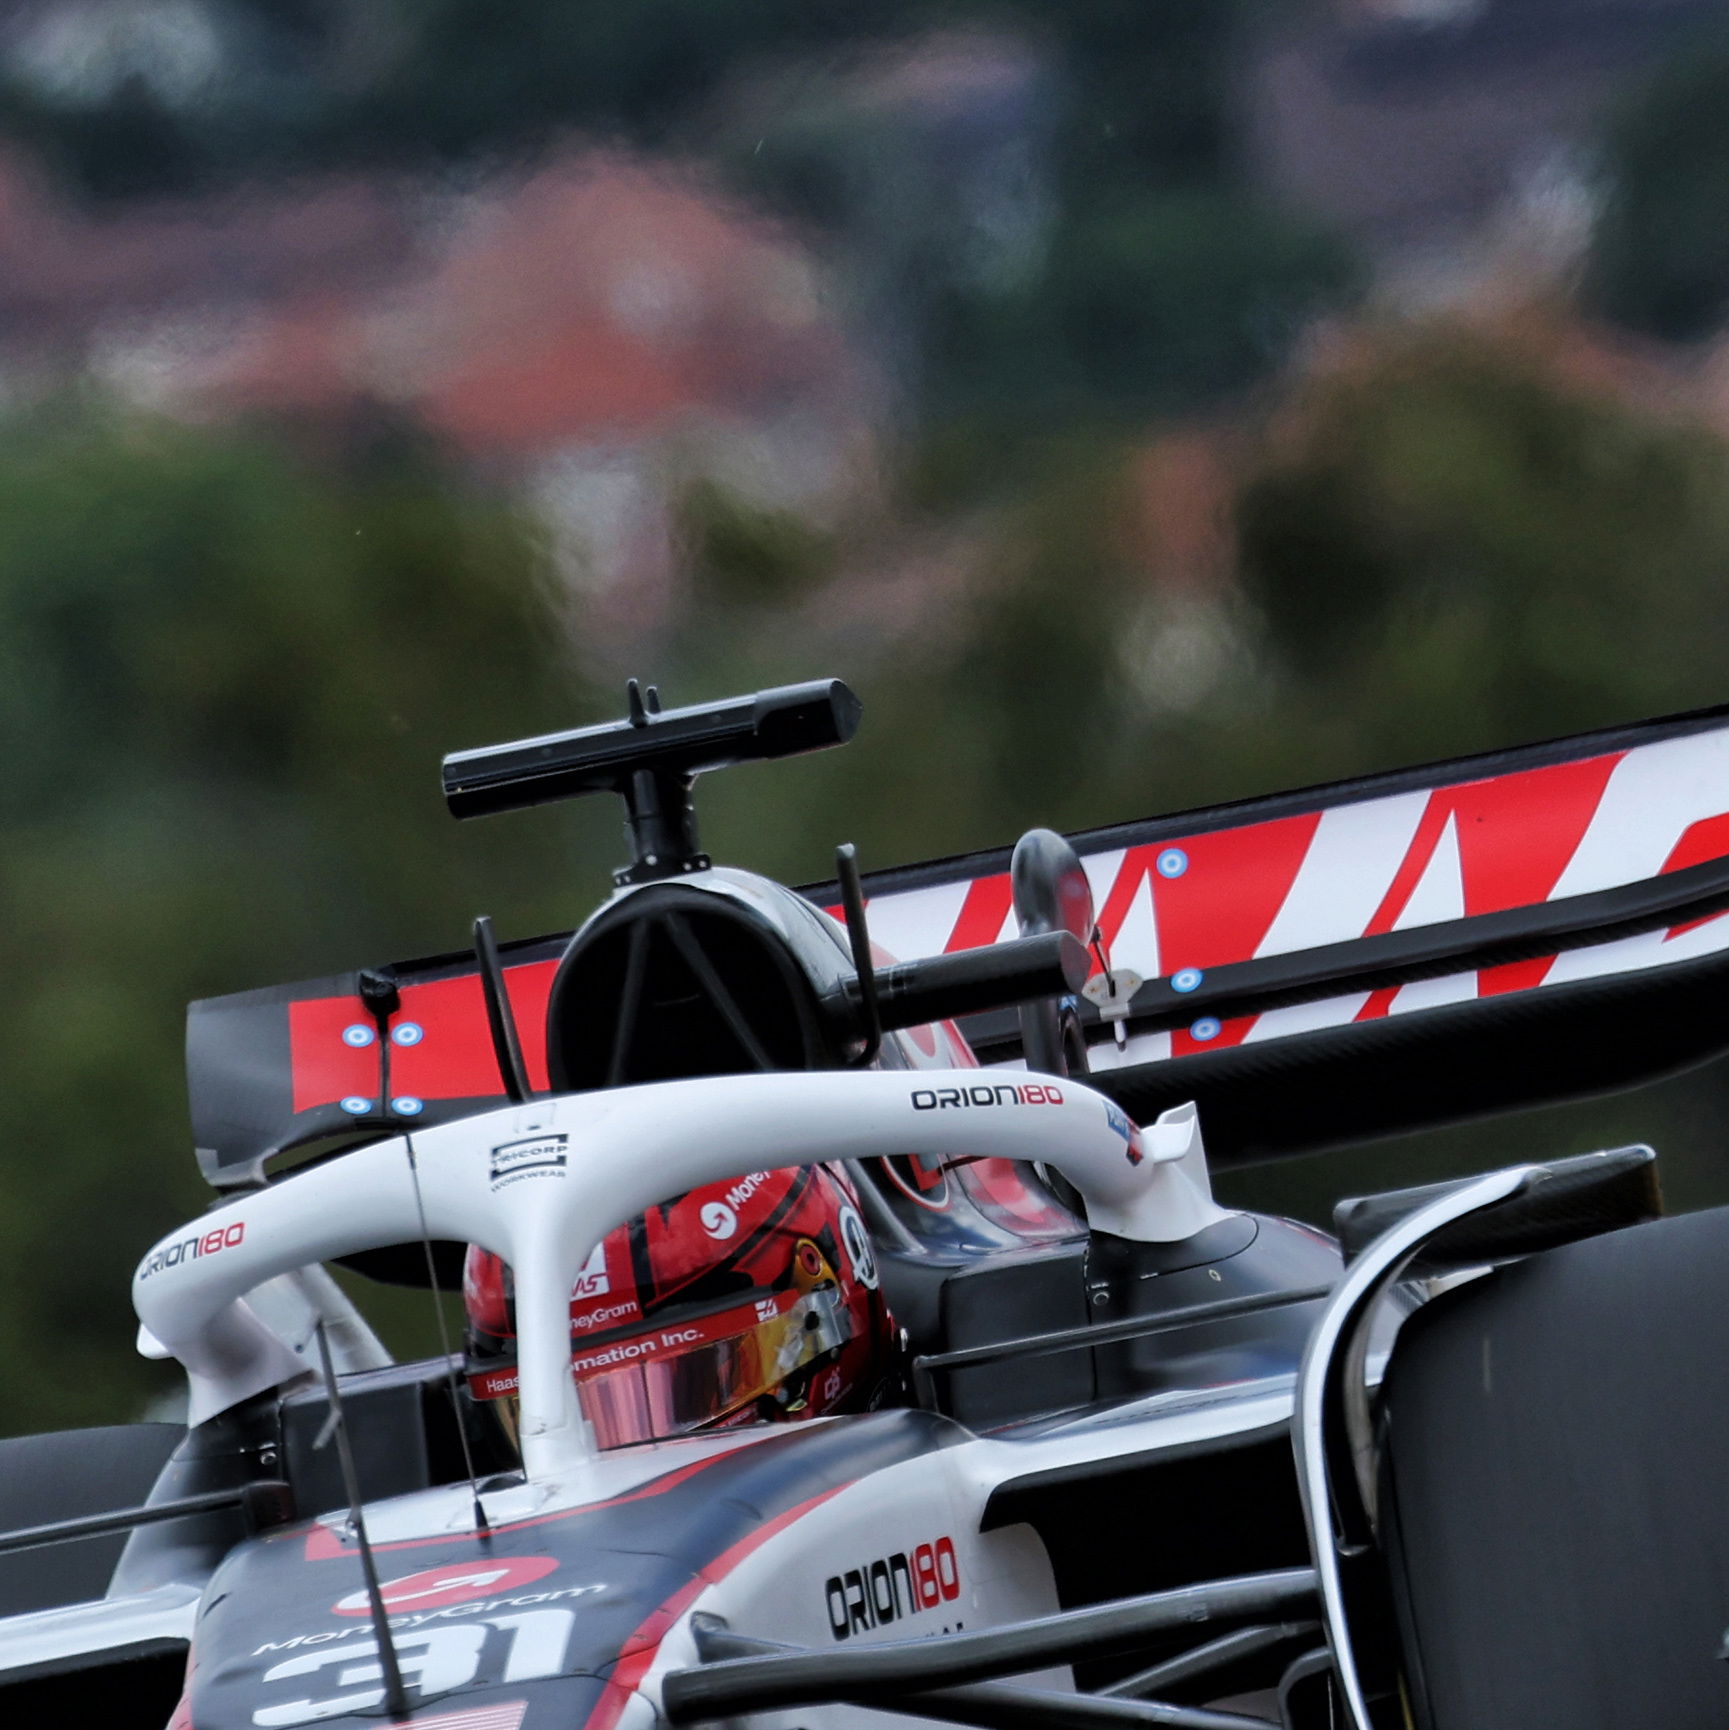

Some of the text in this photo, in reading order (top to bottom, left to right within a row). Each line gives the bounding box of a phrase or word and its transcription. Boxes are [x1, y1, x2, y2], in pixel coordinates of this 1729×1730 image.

[911, 1084, 1064, 1110] ORION180
[571, 1301, 637, 1329] neyGram
[571, 1340, 656, 1372] mation
[661, 1328, 705, 1347] Inc.
[825, 1536, 960, 1642] ORION180
[252, 1609, 576, 1727] 31
